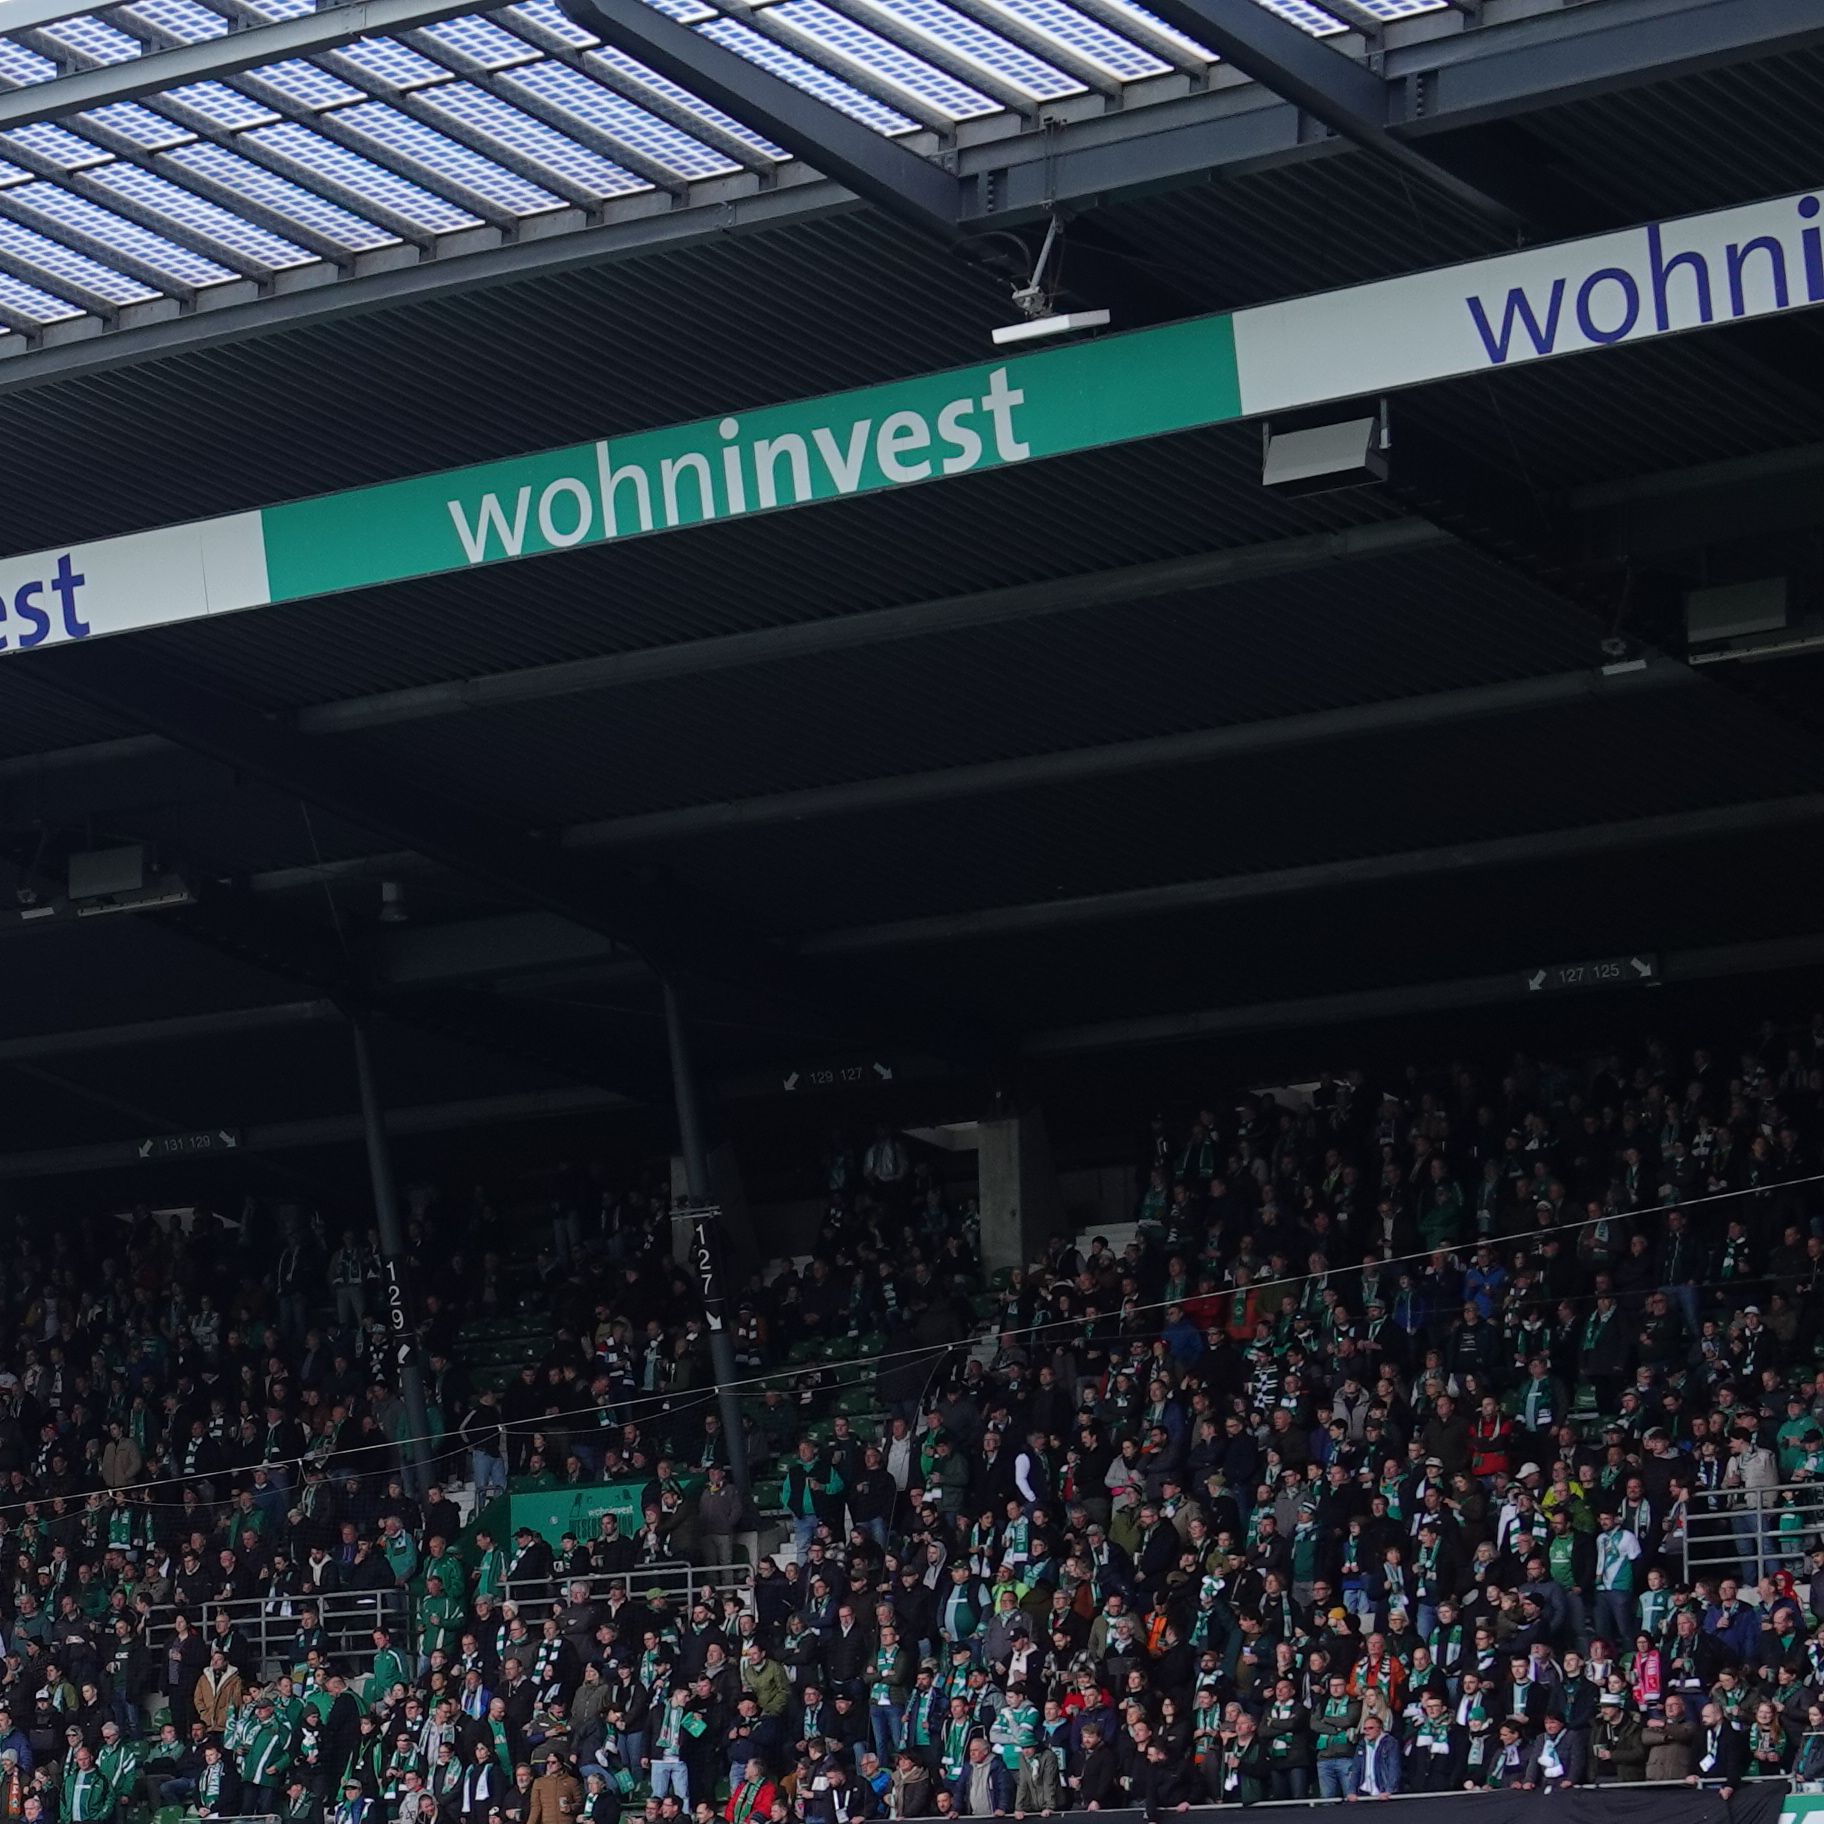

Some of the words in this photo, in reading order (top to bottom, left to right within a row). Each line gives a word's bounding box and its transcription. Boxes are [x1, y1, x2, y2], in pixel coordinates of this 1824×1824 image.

[447, 366, 1029, 563] wohninvest
[1559, 967, 1584, 980] 127
[1593, 963, 1619, 976] 125
[696, 1223, 713, 1295] 127
[387, 1261, 405, 1330] 129
